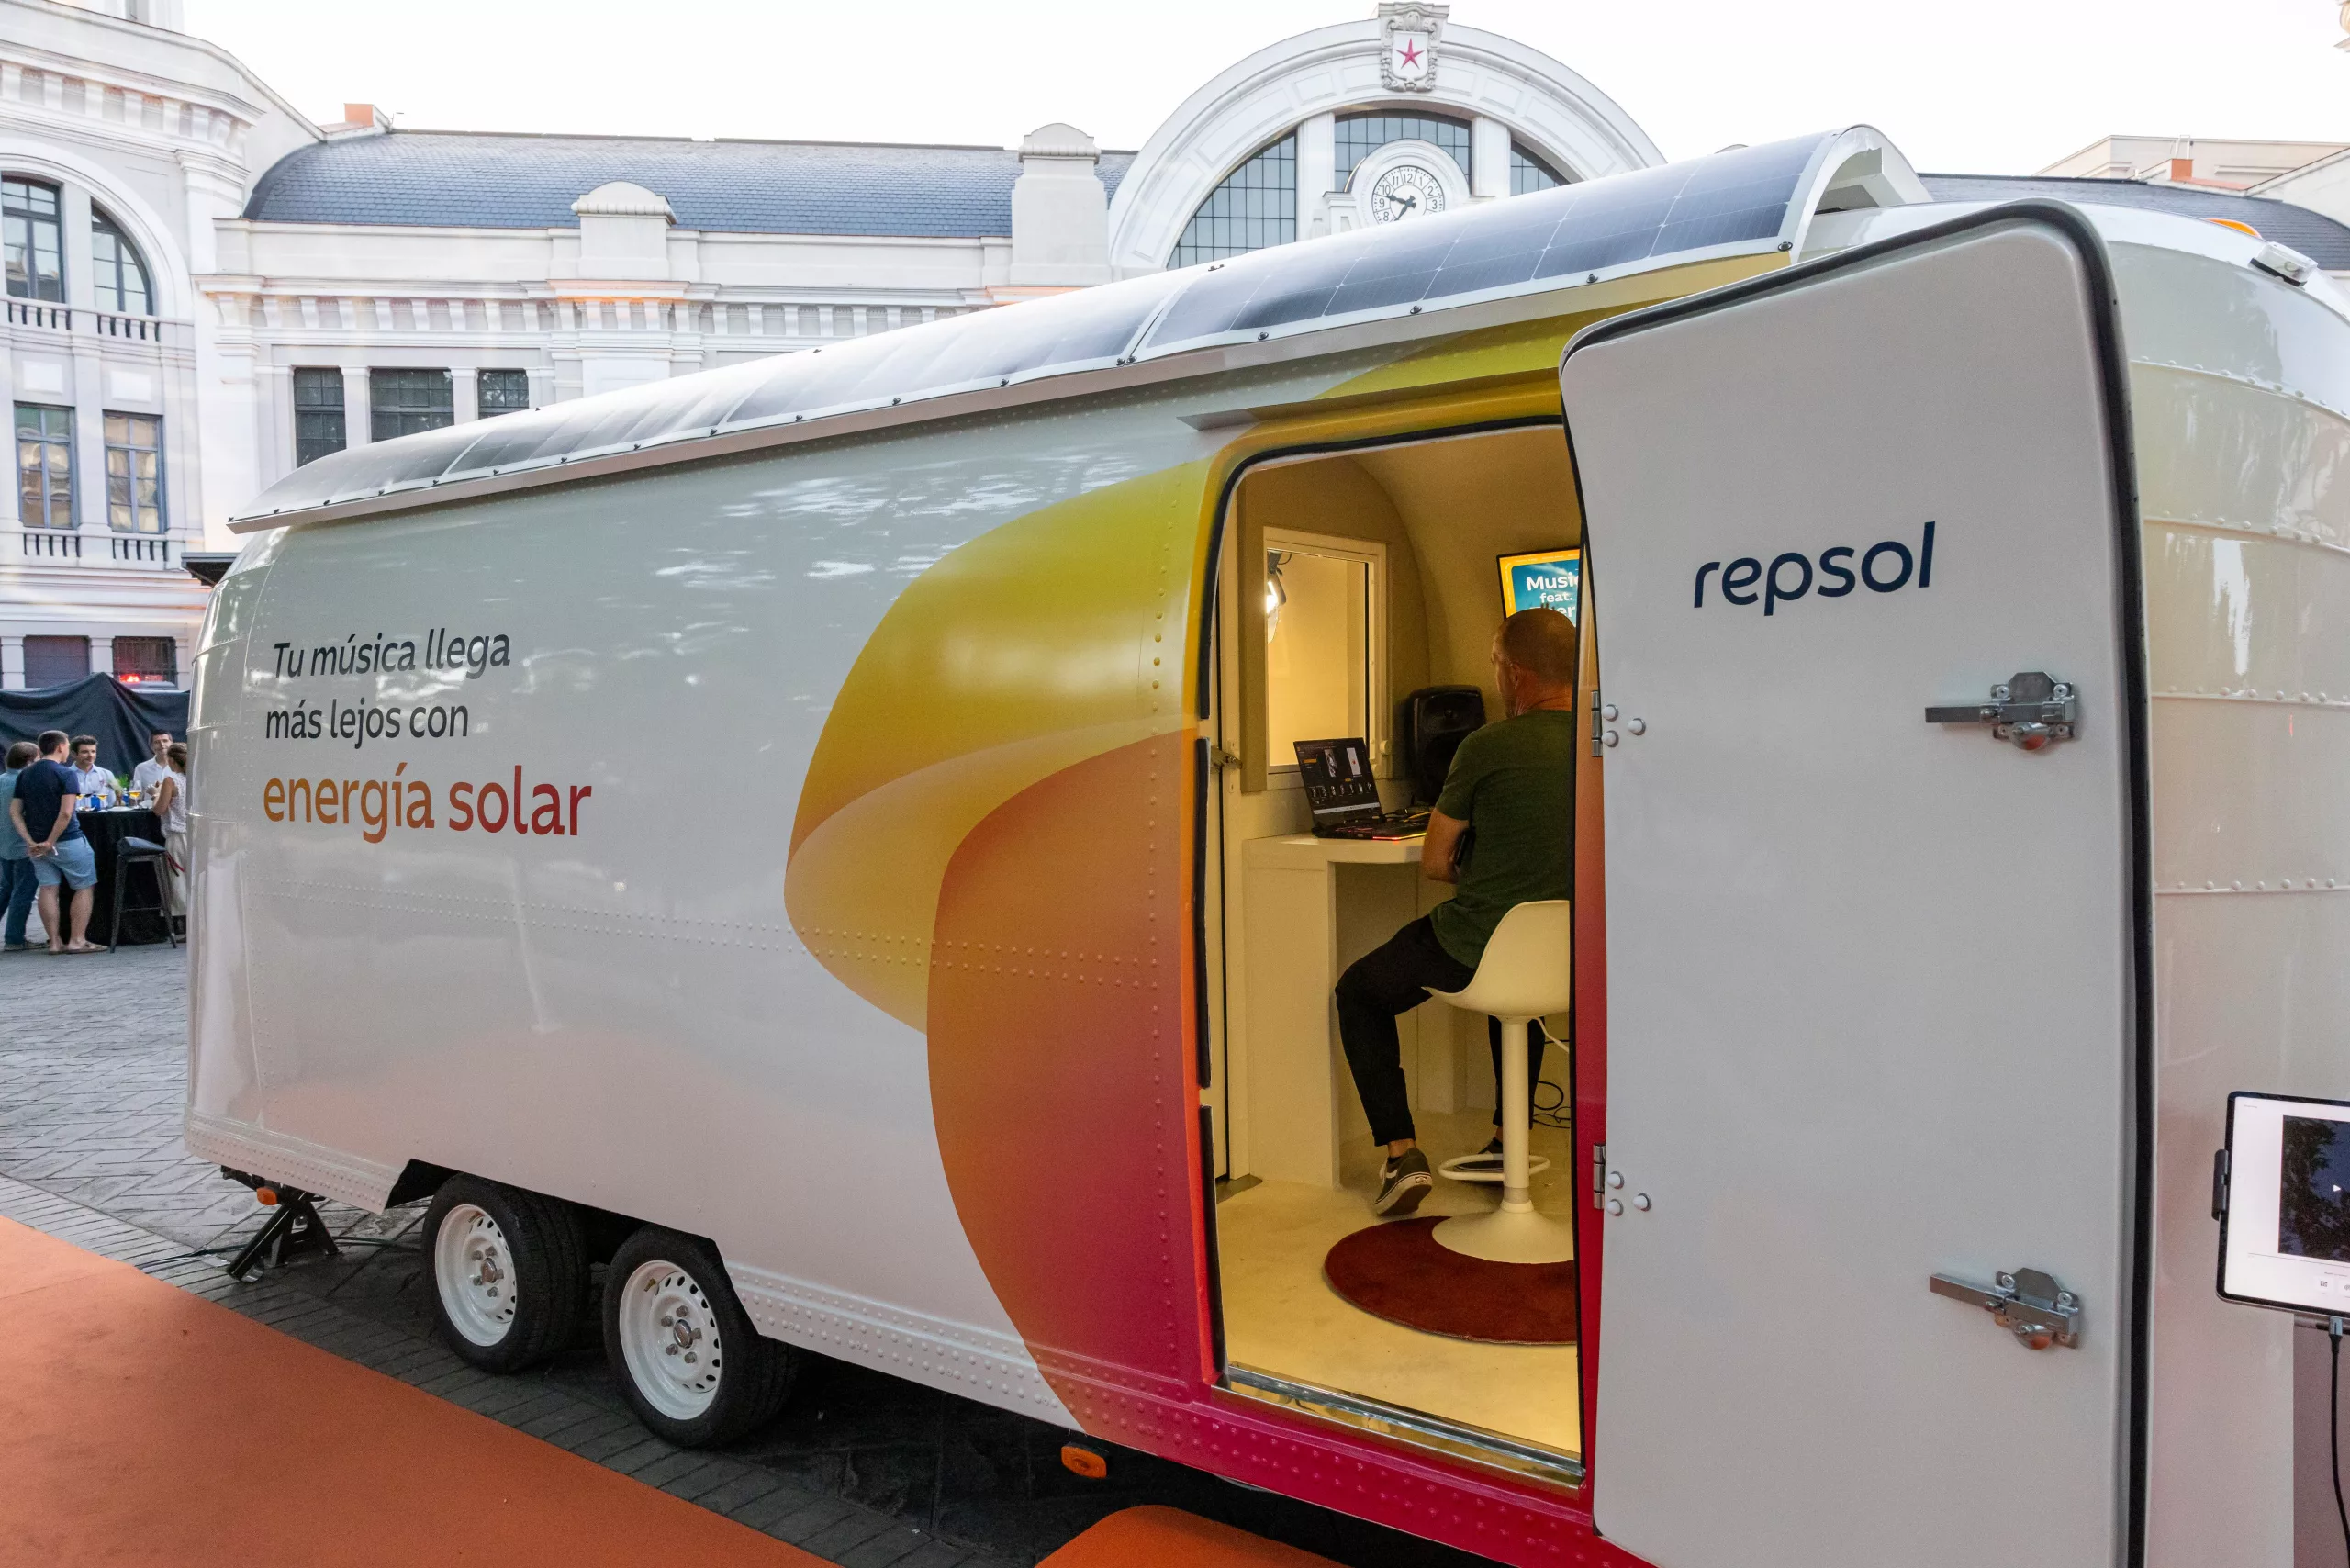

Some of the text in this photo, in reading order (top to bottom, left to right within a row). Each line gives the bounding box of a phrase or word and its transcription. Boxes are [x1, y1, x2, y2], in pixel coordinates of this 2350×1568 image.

[1393, 175, 1400, 186] 11
[1403, 173, 1414, 185] 12
[1382, 185, 1392, 196] 10
[1427, 185, 1434, 196] 2
[1379, 197, 1385, 208] 9
[1431, 199, 1438, 210] 3
[1383, 211, 1390, 222] 8
[1693, 521, 1936, 617] repsol
[1539, 592, 1573, 604] feat.
[274, 628, 511, 680] Tu música llega
[265, 697, 469, 749] más lejos con
[263, 762, 593, 844] energía solar
